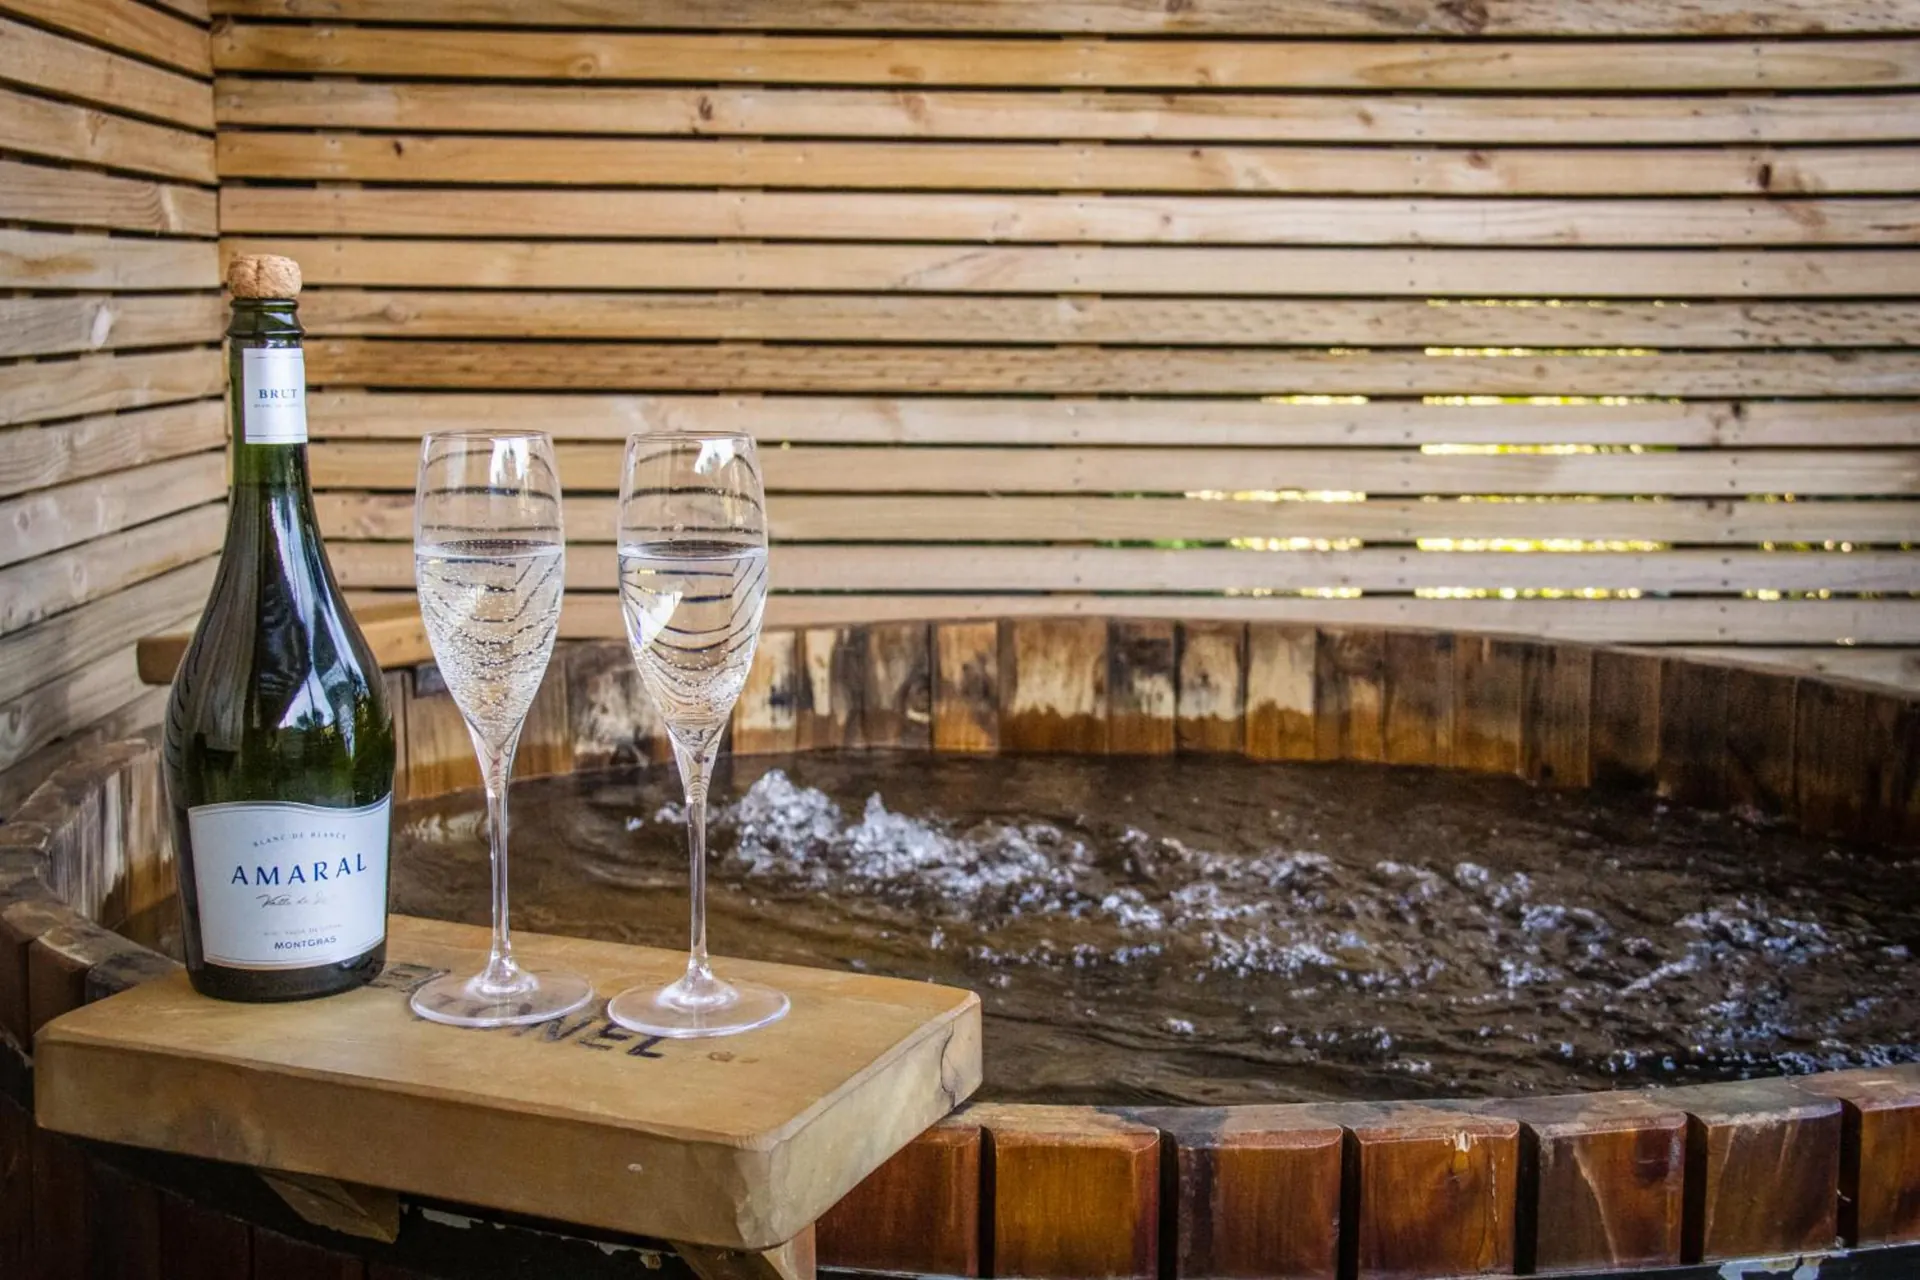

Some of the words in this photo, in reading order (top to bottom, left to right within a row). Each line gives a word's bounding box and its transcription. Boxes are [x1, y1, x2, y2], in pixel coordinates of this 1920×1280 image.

[258, 388, 298, 399] BRUT
[231, 853, 367, 886] AMARAL
[274, 936, 337, 950] MONTGRAS
